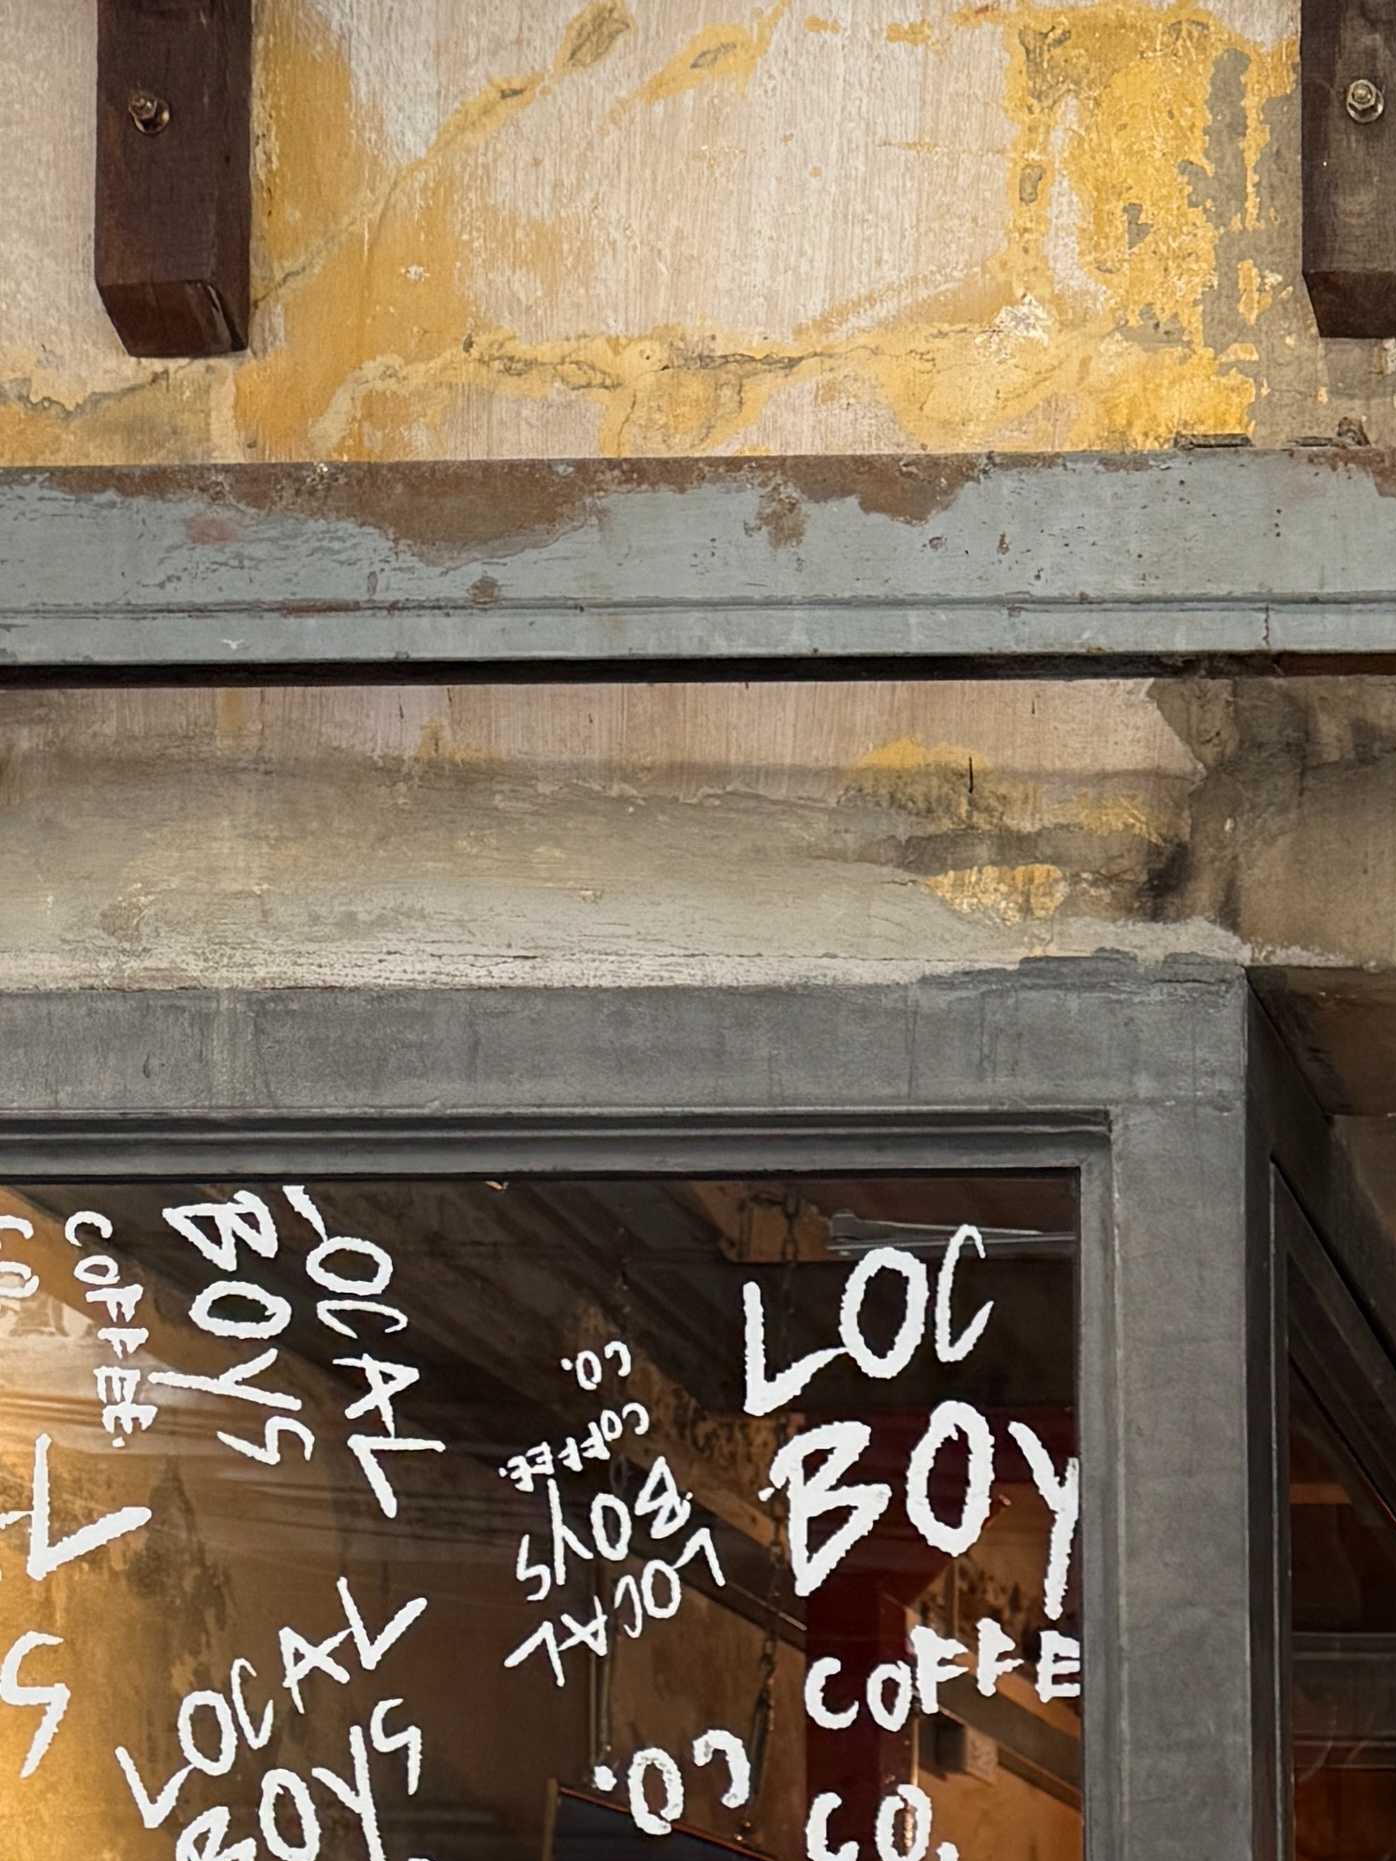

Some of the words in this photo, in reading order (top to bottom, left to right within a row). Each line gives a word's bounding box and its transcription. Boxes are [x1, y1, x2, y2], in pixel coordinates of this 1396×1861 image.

[64, 1210, 159, 1448] COFFEE.
[146, 1189, 316, 1466] BOYS
[560, 1340, 632, 1391] CO.
[742, 1223, 994, 1417] LOC
[496, 1401, 650, 1493] COFFEE.
[758, 1399, 1079, 1621] BOY
[504, 1527, 726, 1687] LOCAL
[516, 1455, 692, 1602] BOYS
[114, 1576, 428, 1829] LOCAL
[804, 1617, 1081, 1733] COFFE
[593, 1729, 751, 1836] CO.
